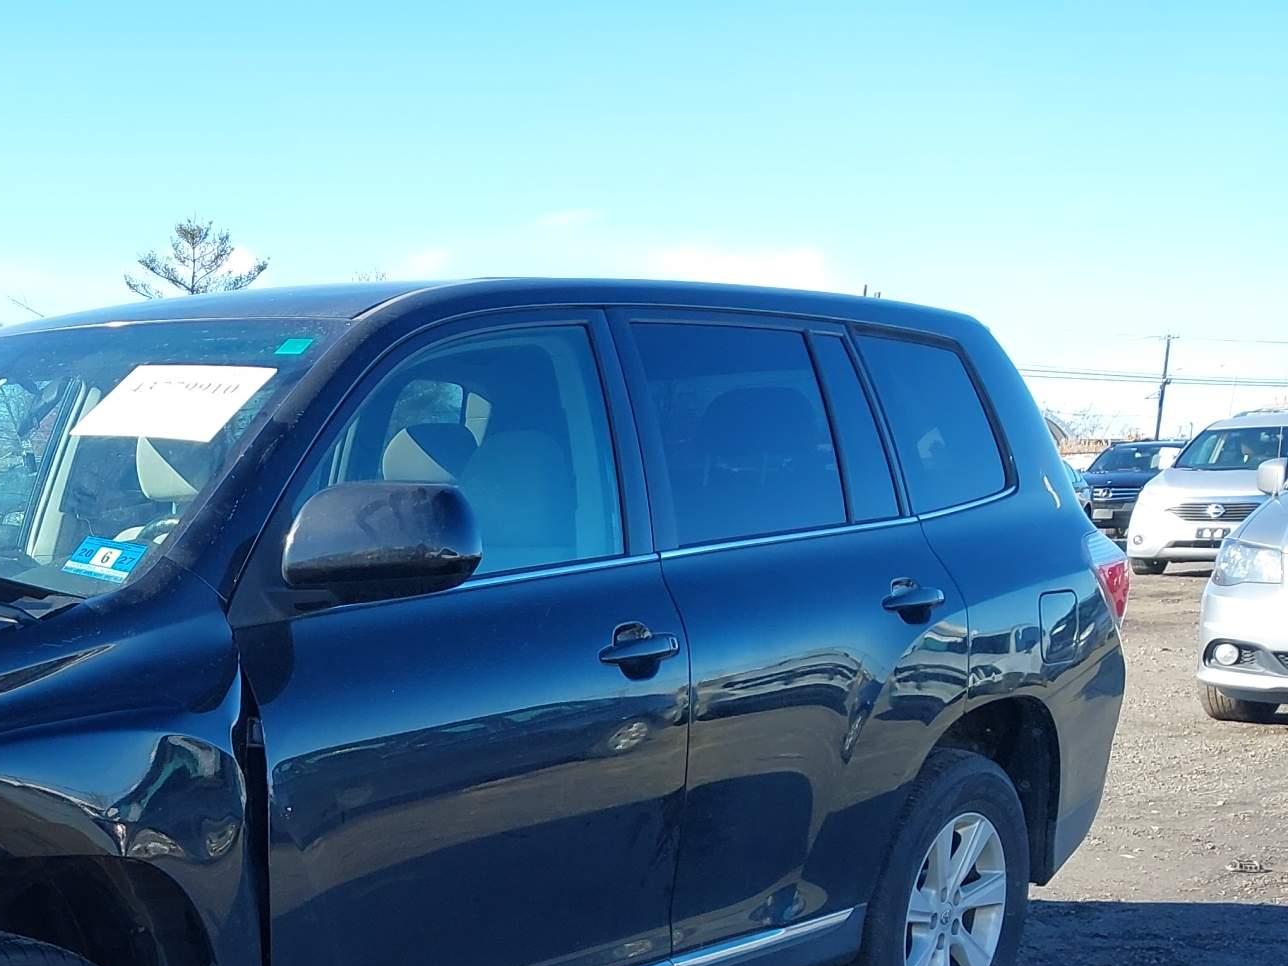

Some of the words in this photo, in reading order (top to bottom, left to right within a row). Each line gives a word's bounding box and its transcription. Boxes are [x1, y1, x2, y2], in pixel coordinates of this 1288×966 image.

[78, 547, 95, 558] 20
[100, 550, 113, 564] 6
[118, 555, 136, 567] 27
